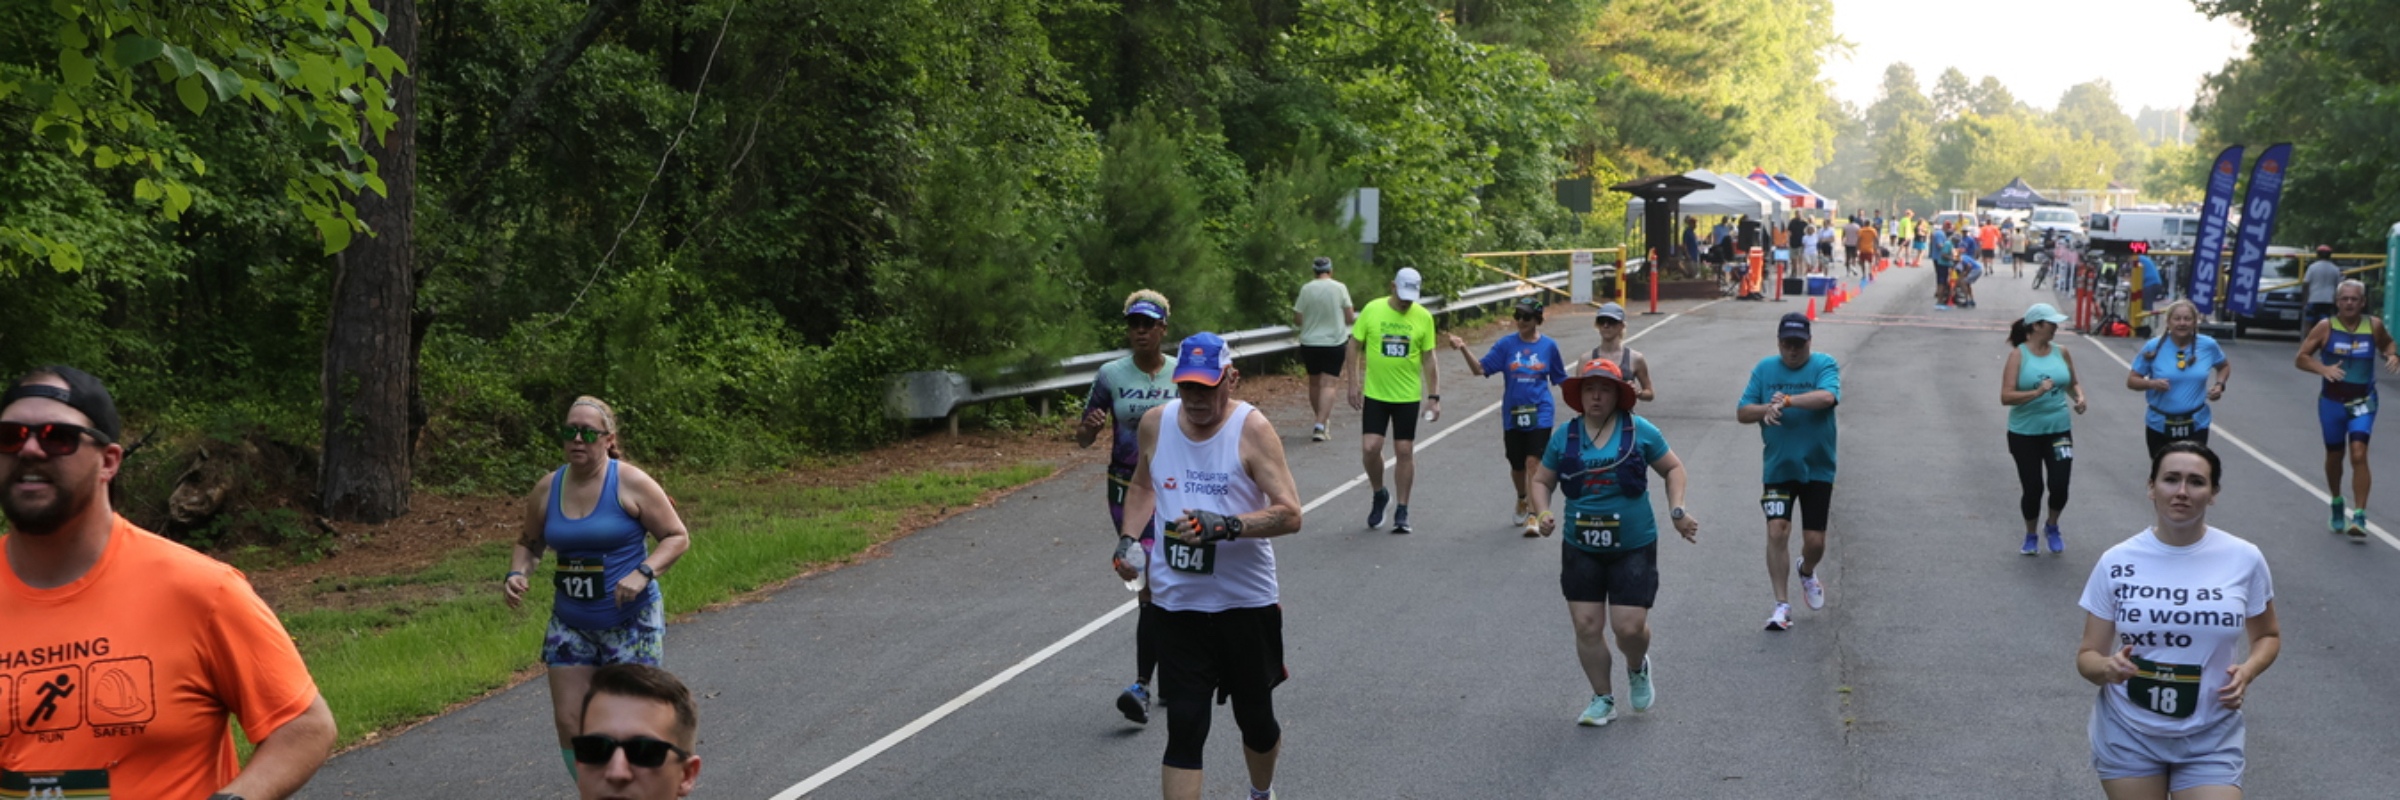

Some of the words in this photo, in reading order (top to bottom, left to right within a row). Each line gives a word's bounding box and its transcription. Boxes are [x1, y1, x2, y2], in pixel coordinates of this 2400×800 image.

[2193, 196, 2228, 306] FINISH
[2234, 197, 2272, 310] START
[1386, 344, 1405, 356] 153
[1118, 387, 1180, 399] VARL
[1186, 469, 1228, 481] TIDEWATER
[1184, 482, 1228, 495] STRIDERS
[1582, 530, 1612, 547] 129
[1170, 544, 1204, 571] 154
[2111, 564, 2135, 579] as
[562, 577, 593, 598] 121
[2196, 587, 2223, 601] as
[2116, 602, 2142, 623] he
[2149, 609, 2245, 628] woman
[2121, 631, 2157, 647] ext
[2163, 631, 2192, 648] to
[0, 637, 110, 669] HASHING
[2147, 686, 2178, 714] 18
[38, 732, 64, 743] RUN
[93, 726, 146, 738] SAFETY
